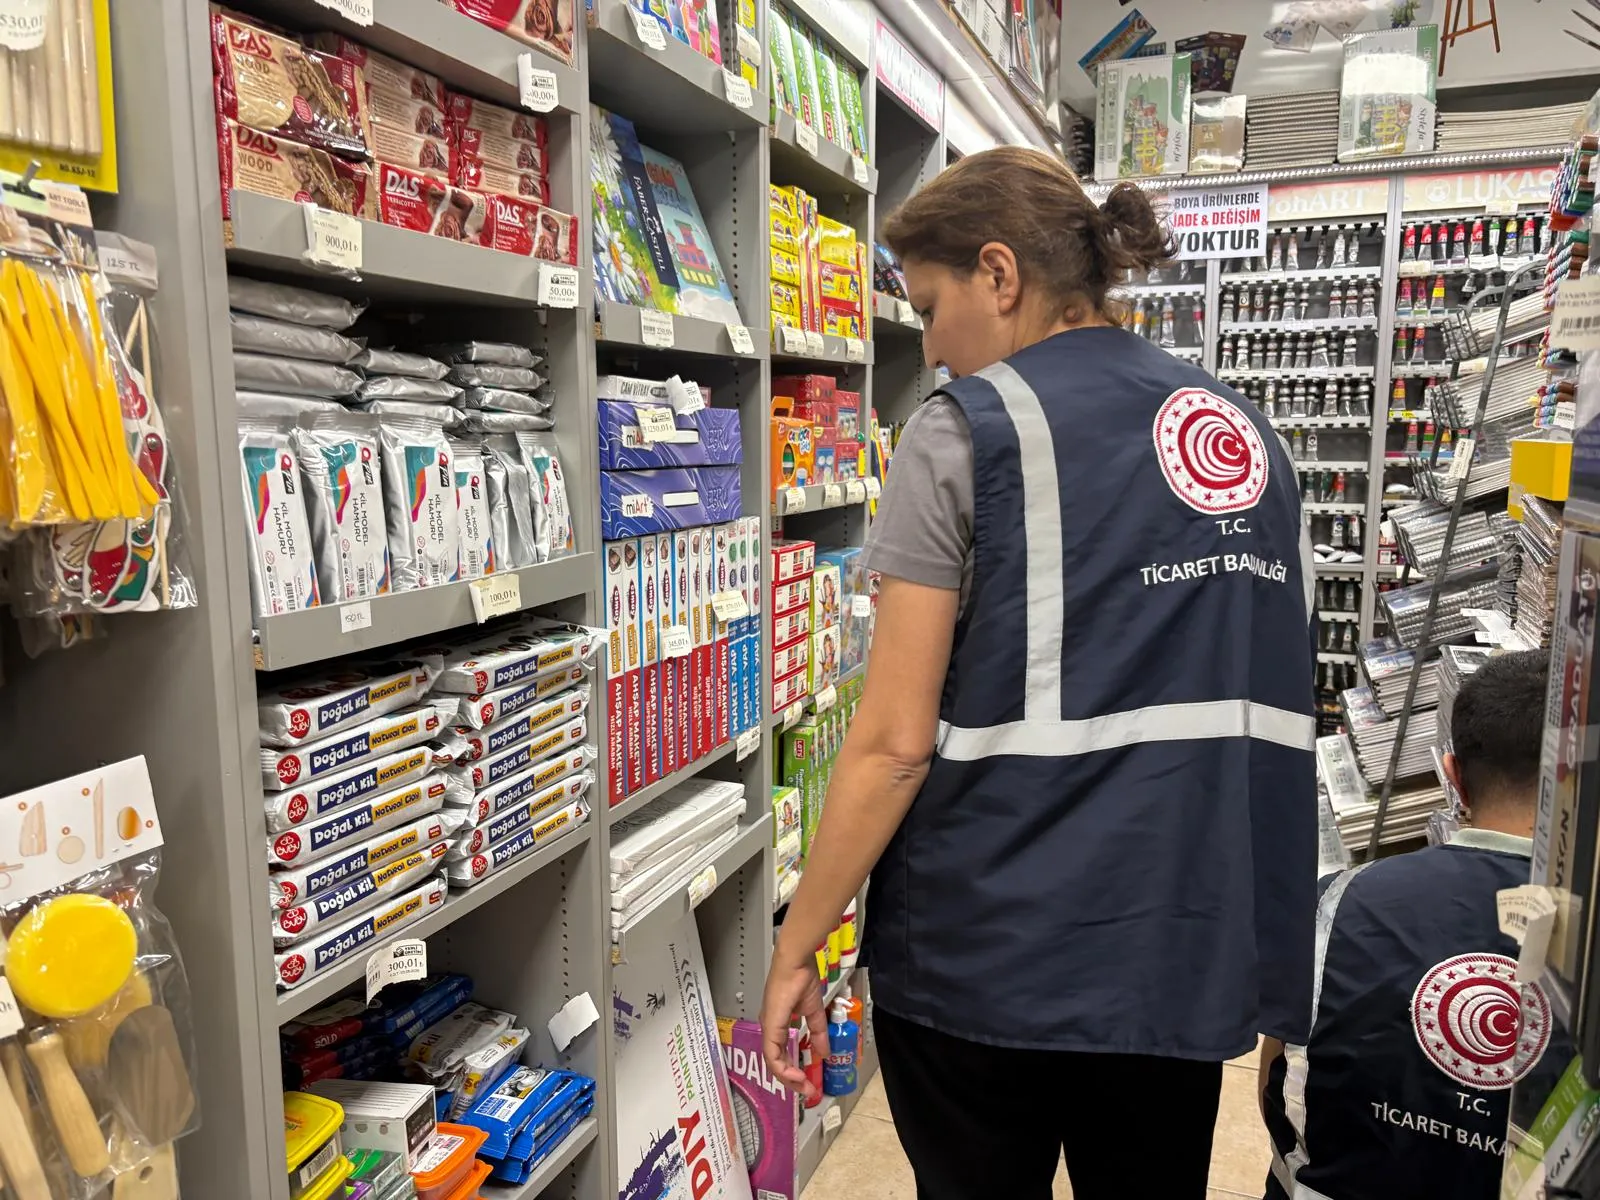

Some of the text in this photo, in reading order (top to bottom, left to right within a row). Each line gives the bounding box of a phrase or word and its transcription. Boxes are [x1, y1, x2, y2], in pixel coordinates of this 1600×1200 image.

[228, 24, 272, 59] DAS
[238, 152, 273, 173] WOOD
[386, 170, 420, 197] DAS
[1174, 191, 1260, 209] BOYA ÜRÜNLERDE
[497, 201, 521, 223] DAS
[1173, 208, 1260, 229] İADE & DEĞİŞİM
[1175, 229, 1260, 253] YOKTUR
[352, 498, 362, 543] HAMURU
[428, 499, 437, 540] HAMURU
[626, 500, 648, 514] miArt
[273, 507, 287, 555] HAMURU
[280, 502, 295, 559] KİL MODEL
[361, 510, 369, 547] MODEL
[435, 511, 444, 544] MODEL
[1215, 518, 1251, 535] T.C.
[1140, 555, 1220, 586] TİCARET
[497, 660, 537, 683] Doğal Kil
[720, 645, 728, 681] AHŞAP
[321, 680, 411, 723] Doğal Kil Natural Clay
[313, 723, 417, 768] Doğal Kil Natural Clay
[616, 732, 624, 794] MAKETİM
[633, 722, 641, 783] MAKETİM
[278, 765, 300, 779] BUBU
[321, 757, 423, 806] Doğal Kil Natural Clay
[289, 803, 308, 819] BUBU
[314, 791, 421, 844] Doğal Kil Natural Clay
[276, 843, 300, 857] BUBU
[310, 835, 416, 891] Doğal Kil Natural Clay
[320, 855, 423, 914] Doğal Kil Natural Clay
[283, 913, 307, 929] BUBU
[320, 900, 420, 963] Doğal Kil Natural Clay
[282, 963, 306, 978] BUBU
[666, 1031, 688, 1110] DIGITAL
[674, 1023, 696, 1101] PAINTING
[1371, 1102, 1452, 1139] TİCARET
[1457, 1091, 1491, 1117] T.C.
[677, 1110, 714, 1200] DIY
